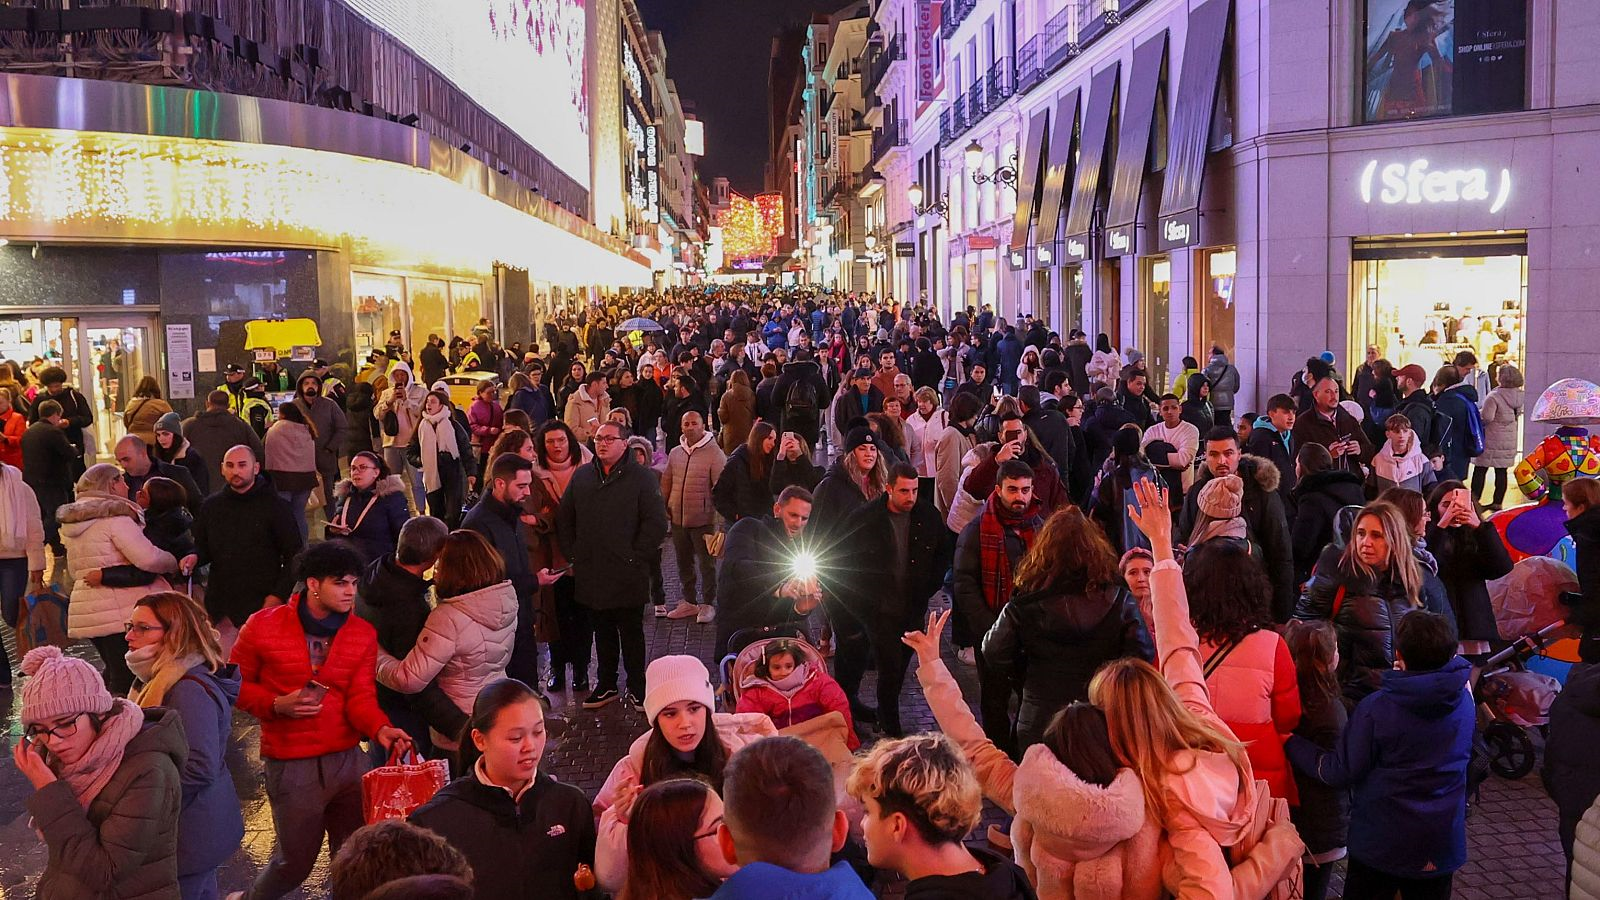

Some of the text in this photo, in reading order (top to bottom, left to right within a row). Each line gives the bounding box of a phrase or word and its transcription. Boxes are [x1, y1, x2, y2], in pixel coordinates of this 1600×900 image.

[918, 5, 933, 97] Foot Locker
[1458, 45, 1473, 54] SHOP
